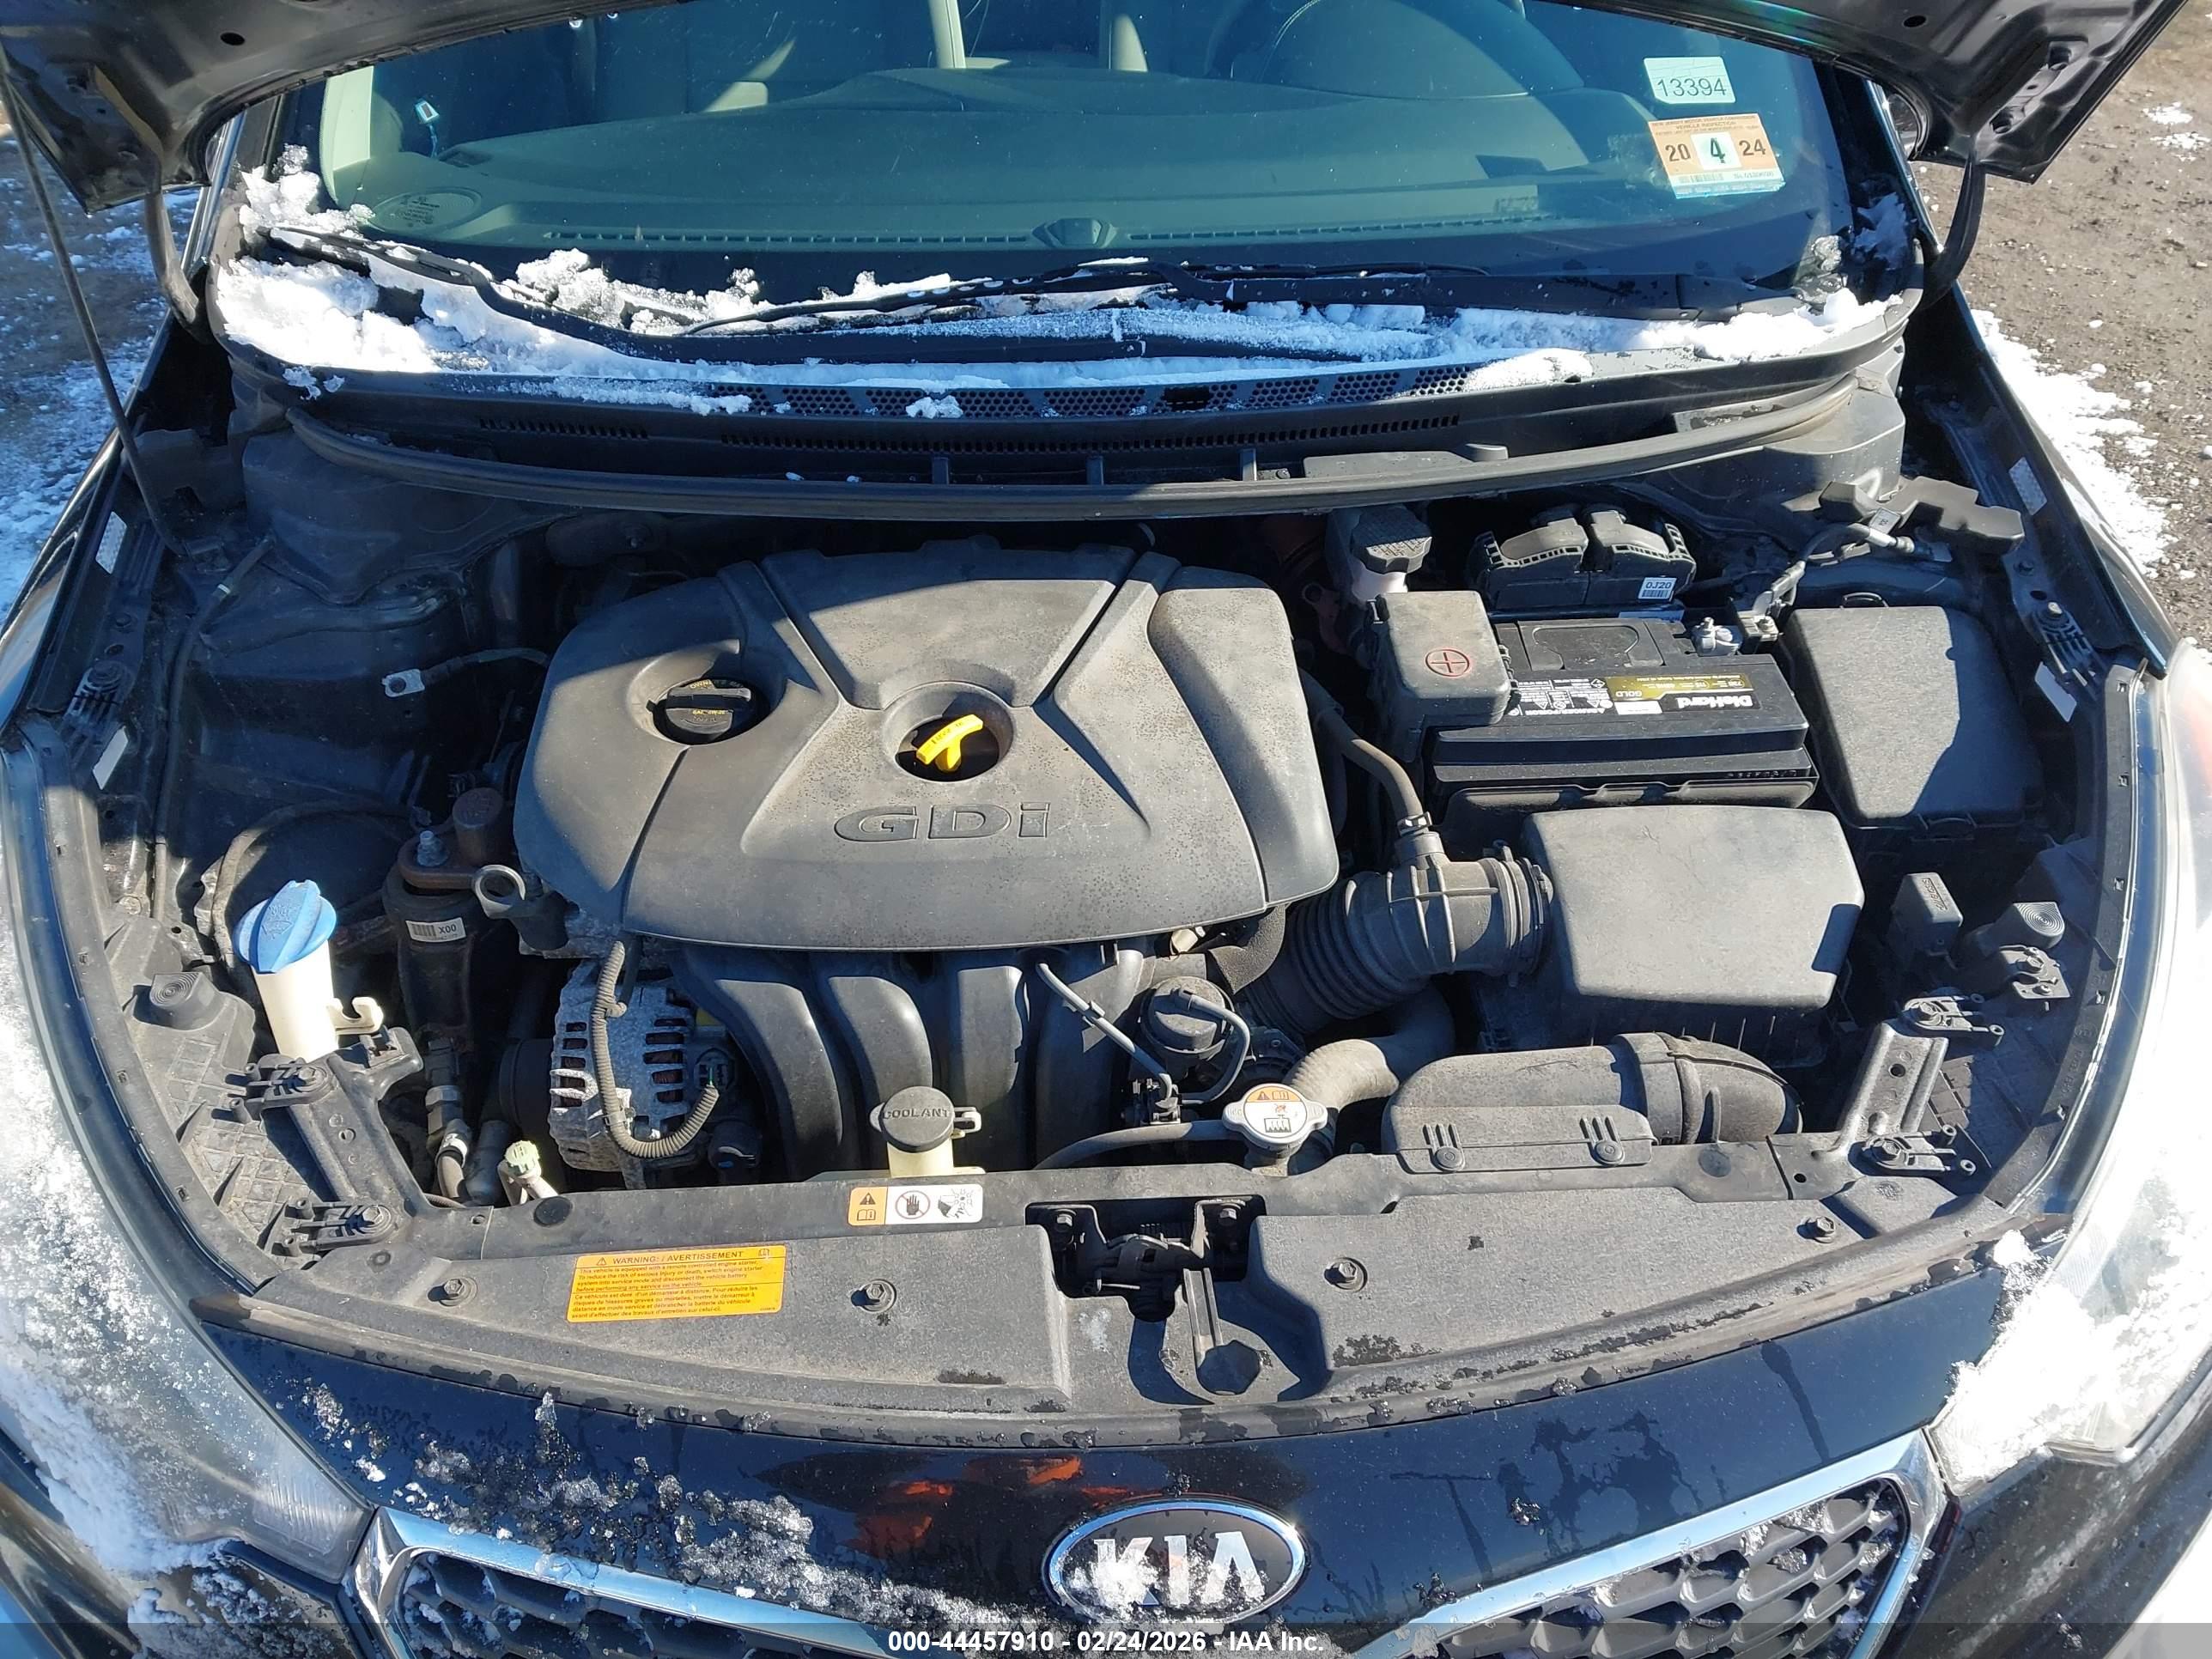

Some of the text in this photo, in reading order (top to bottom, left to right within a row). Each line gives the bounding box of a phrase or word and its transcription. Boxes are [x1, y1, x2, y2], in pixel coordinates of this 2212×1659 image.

[1657, 77, 1727, 96] 13394
[1665, 137, 1766, 163] 20 4 24
[1675, 695, 1753, 708] DieHard
[882, 1108, 950, 1120] COOLANT
[613, 1255, 659, 1264] WARNING:
[667, 1251, 743, 1261] AVERTISSEMENT
[1093, 1531, 1268, 1607] KIA
